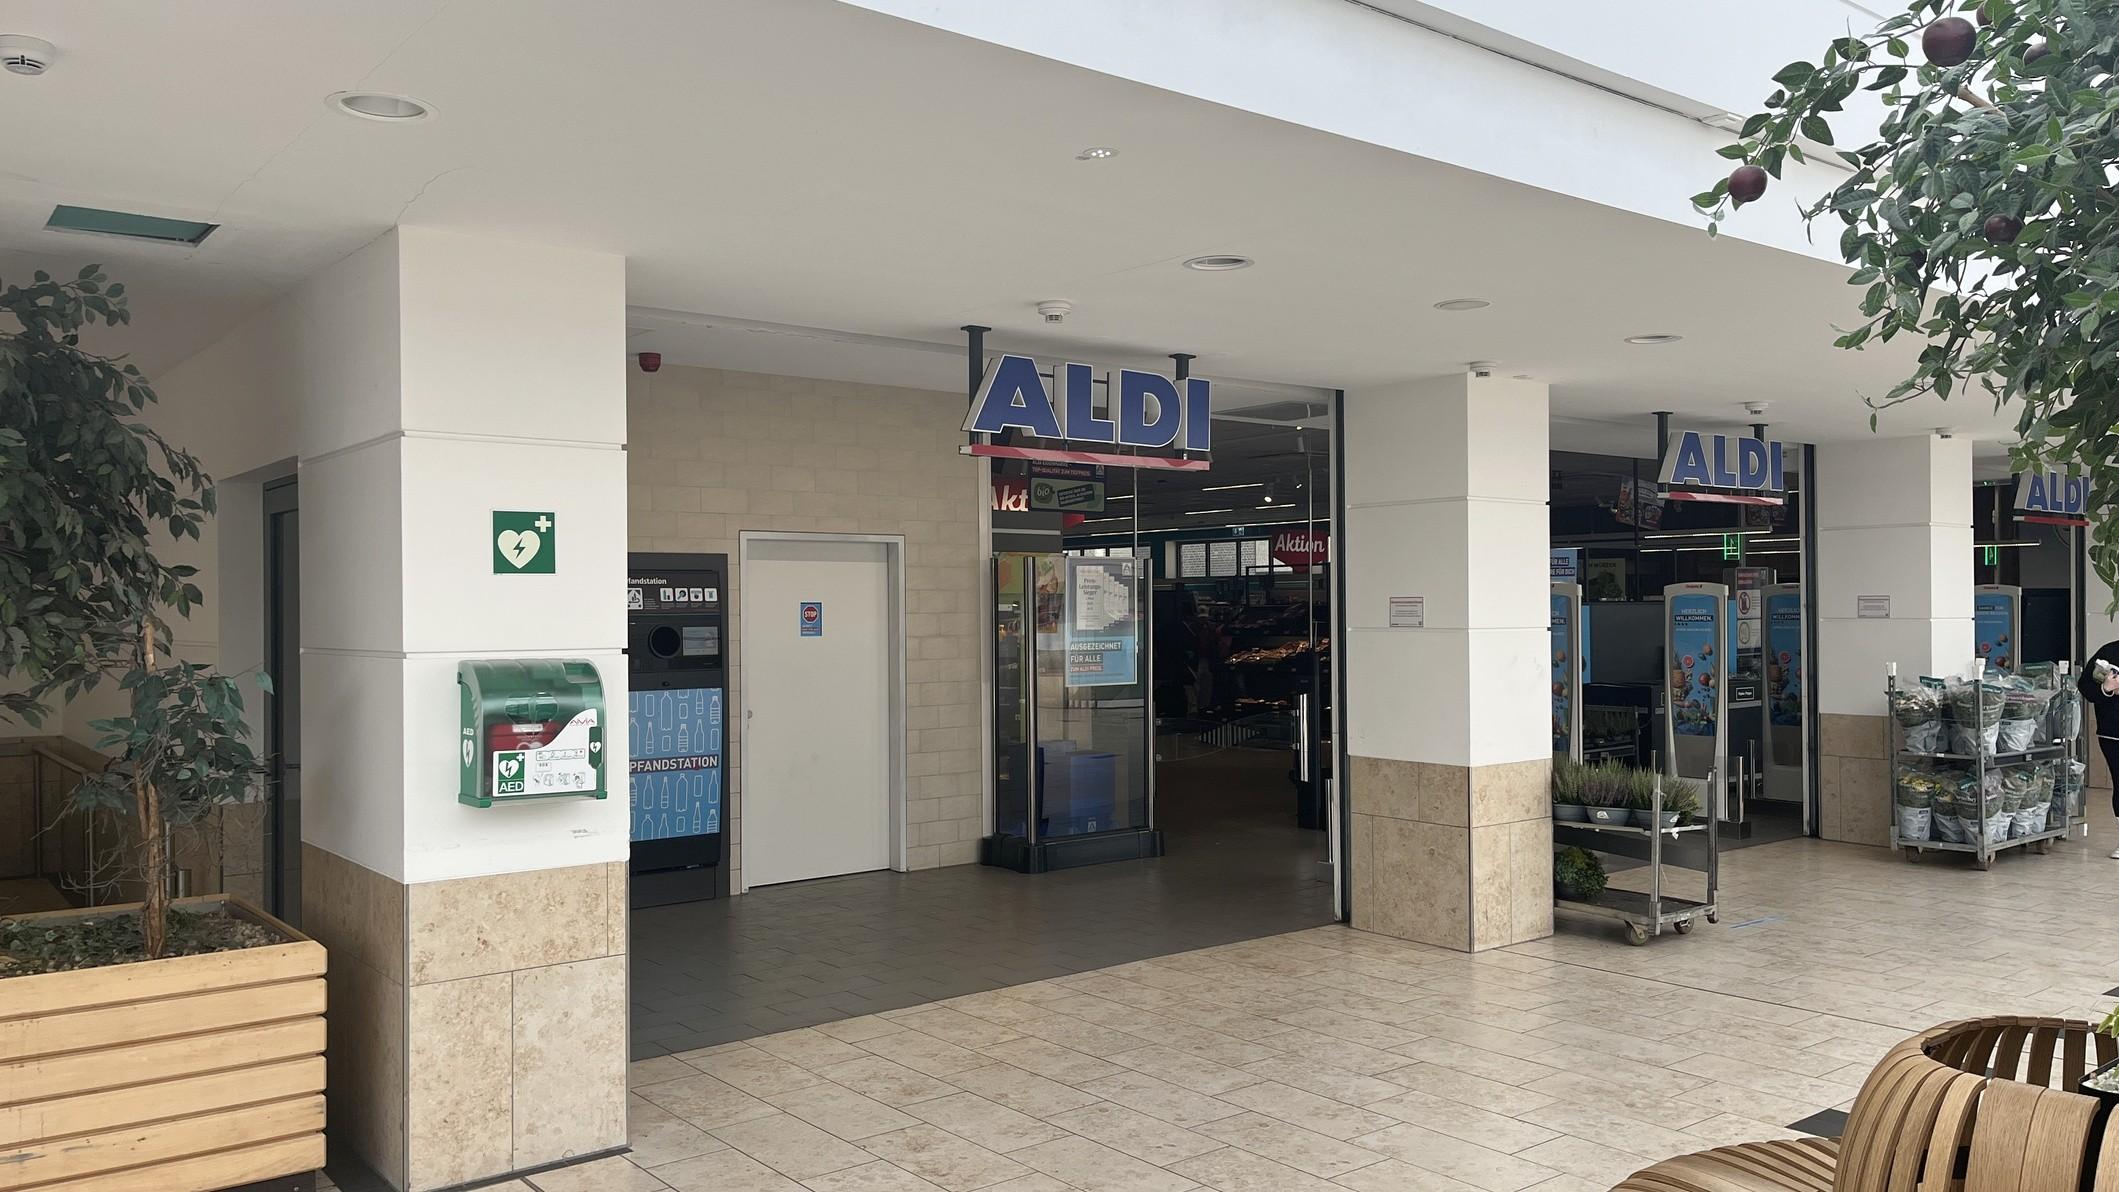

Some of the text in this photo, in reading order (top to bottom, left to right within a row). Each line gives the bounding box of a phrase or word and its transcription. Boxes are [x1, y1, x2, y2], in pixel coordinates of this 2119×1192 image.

[970, 354, 1212, 452] ALDI
[1669, 431, 1784, 492] ALDI
[2024, 472, 2091, 515] ALDI
[1275, 533, 1326, 553] Aktion
[804, 610, 817, 618] STOP
[1070, 641, 1122, 651] AUSGEZEICHNET
[1070, 654, 1102, 663] FÜR ALLE
[462, 727, 474, 736] AED
[629, 755, 719, 774] PFANDSTATION
[498, 782, 525, 793] AED
